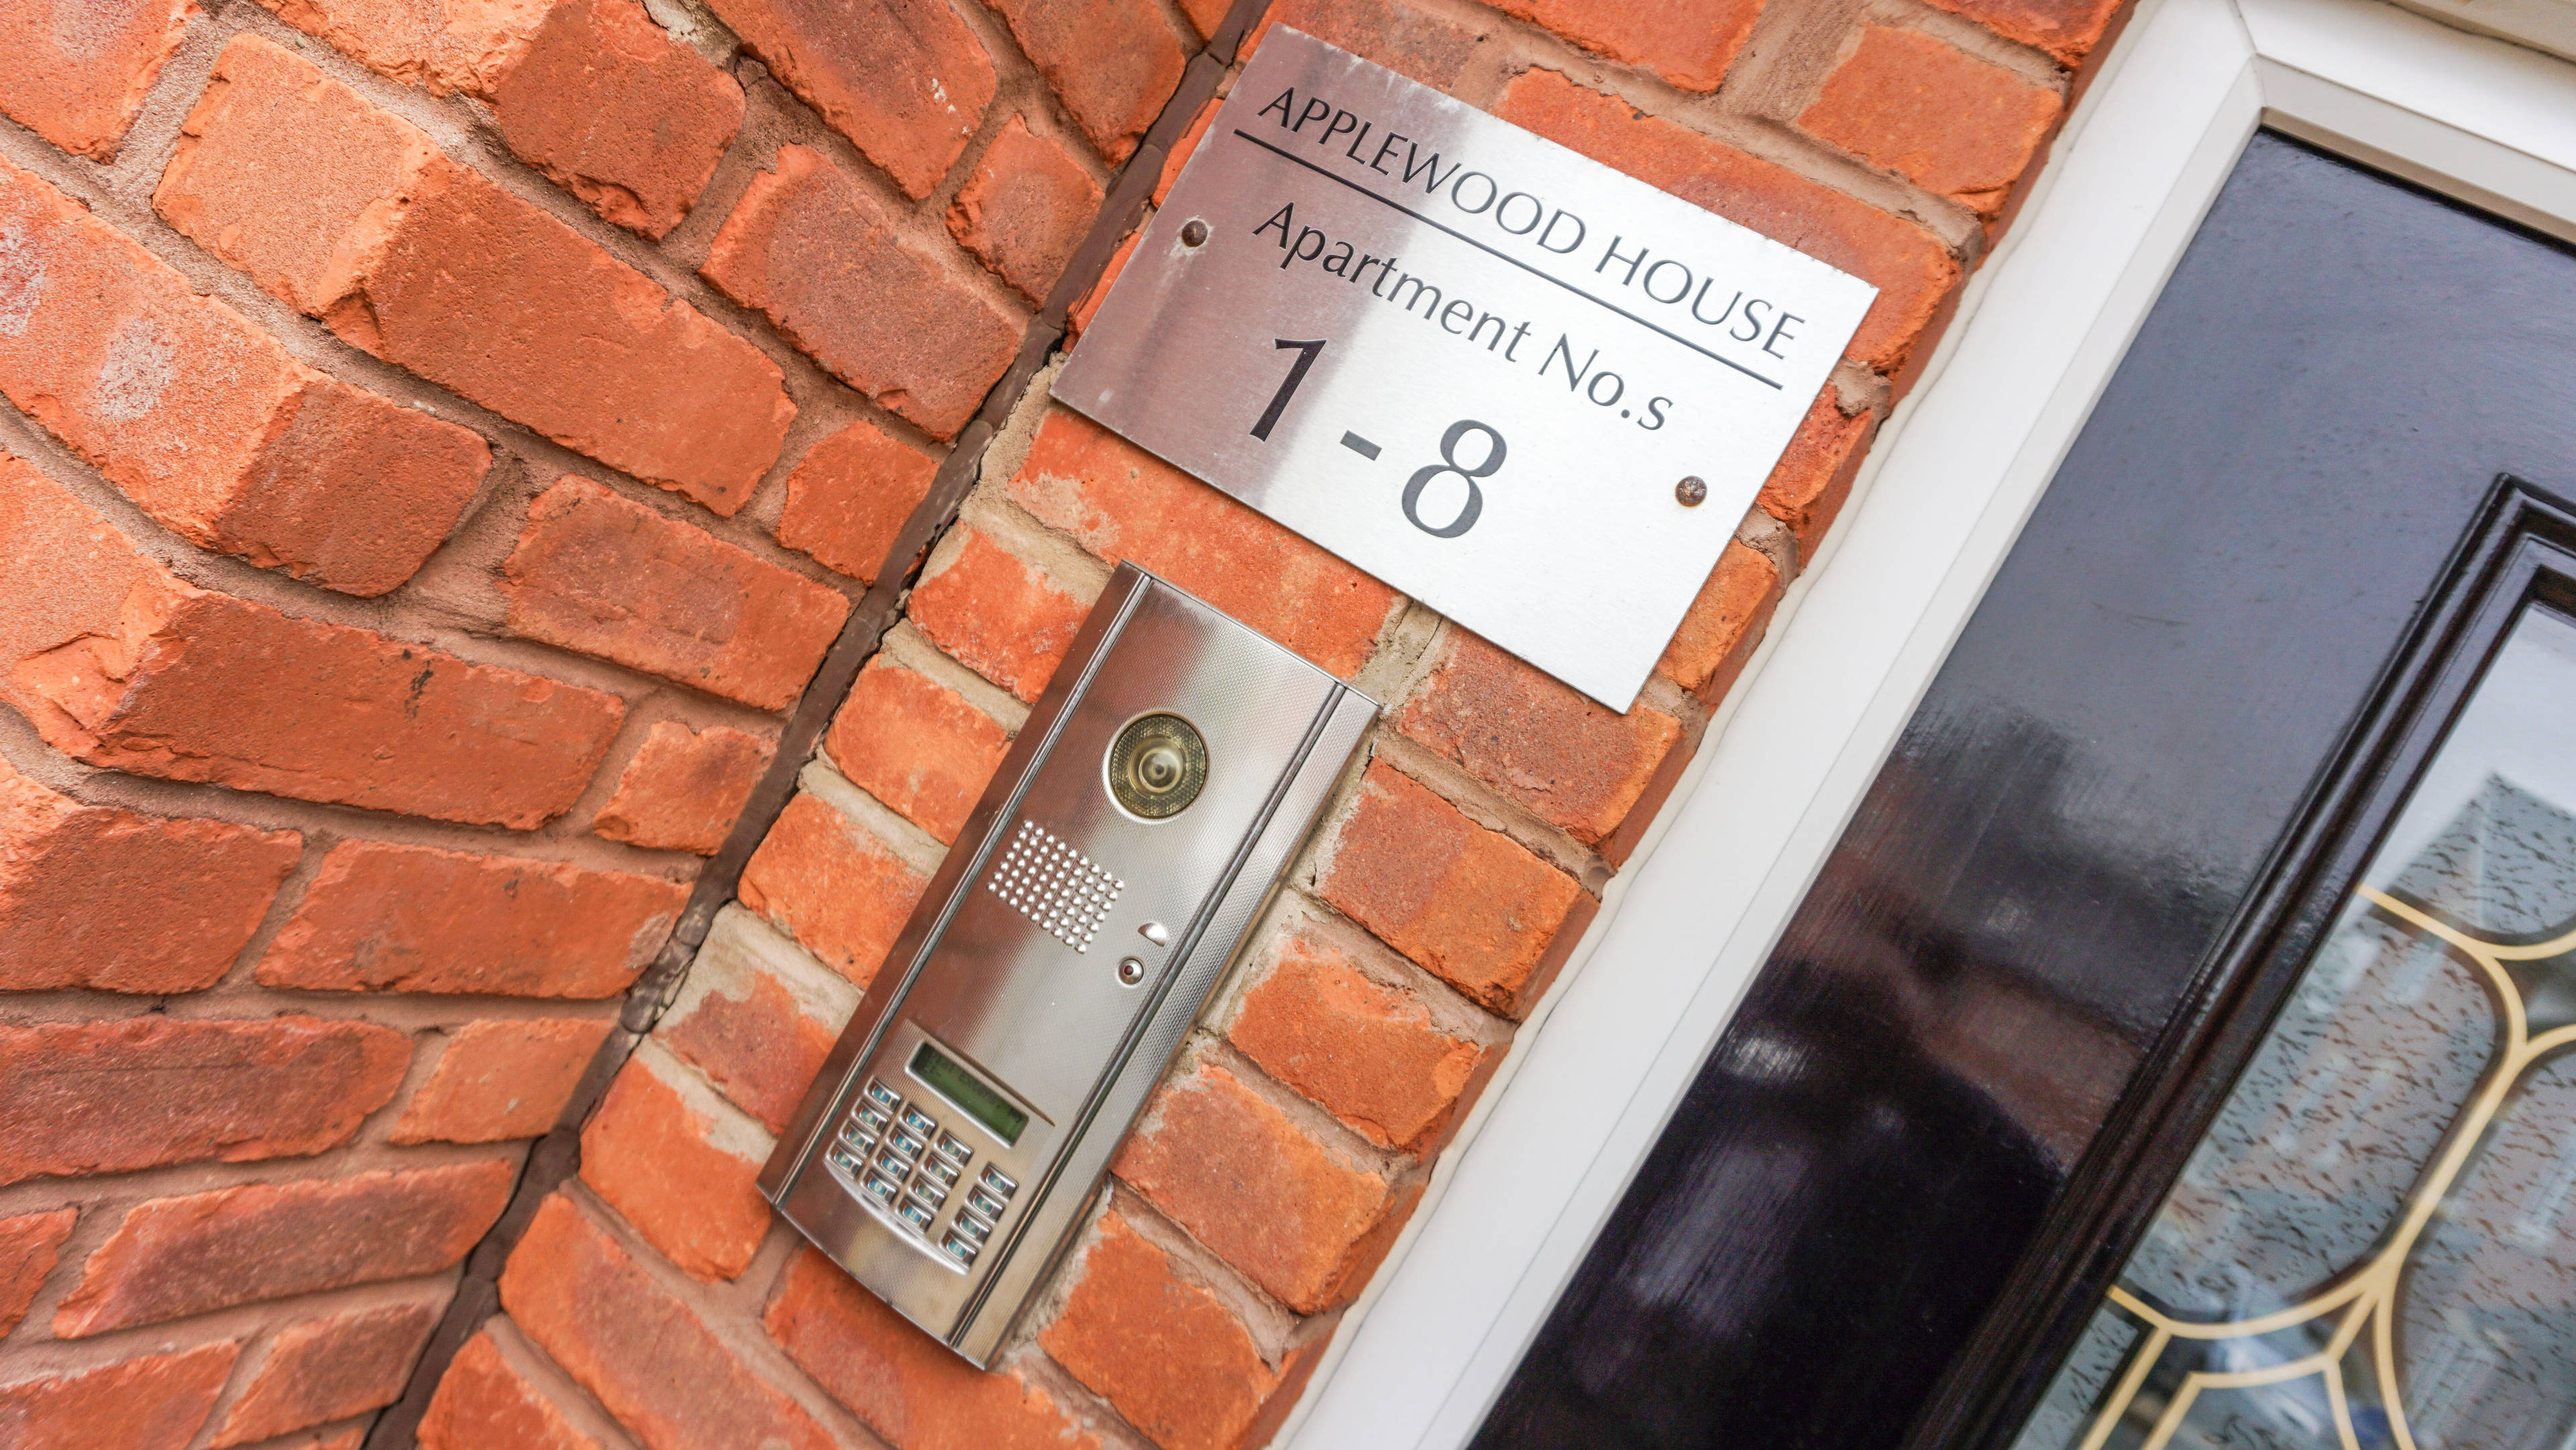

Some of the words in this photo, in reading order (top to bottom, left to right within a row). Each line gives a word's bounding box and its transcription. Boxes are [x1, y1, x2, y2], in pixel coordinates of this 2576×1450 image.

[1252, 202, 1532, 363] Apartment
[1538, 333, 1674, 431] No.s
[1257, 87, 1587, 255] APPLEWOOD
[1595, 236, 1806, 360] HOUSE
[1249, 338, 1327, 443] 1
[1340, 430, 1383, 462] -
[1401, 419, 1507, 539] 8
